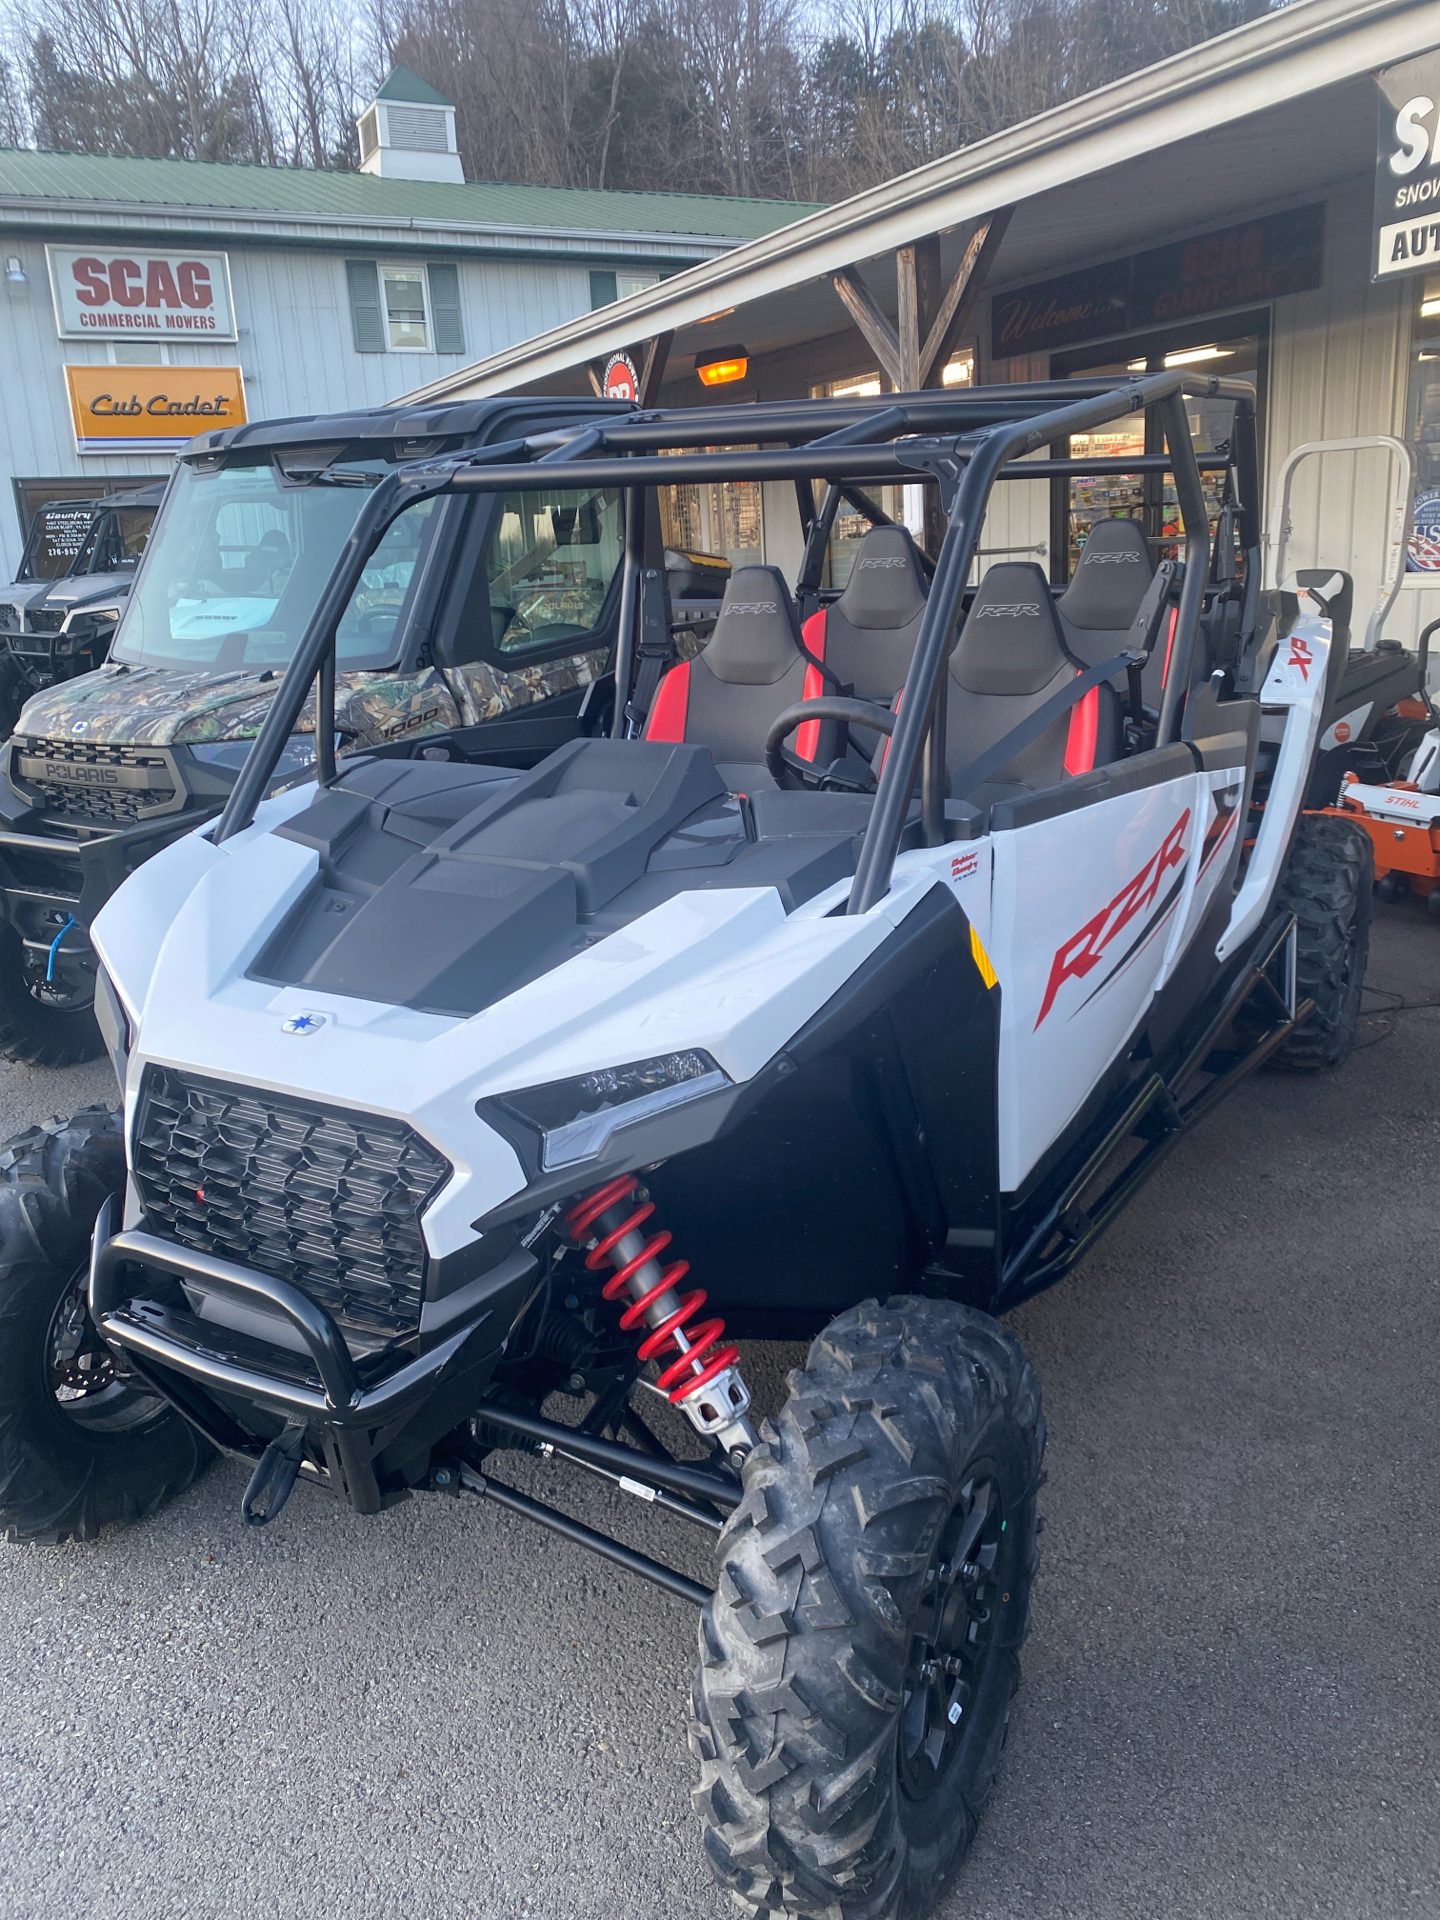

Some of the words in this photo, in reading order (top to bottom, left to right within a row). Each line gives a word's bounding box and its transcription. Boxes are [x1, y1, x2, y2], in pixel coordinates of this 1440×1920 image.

[71, 257, 213, 309] SCAG
[79, 313, 161, 328] COMMERCIAL
[165, 314, 216, 329] MOWERS
[90, 394, 142, 416] Cub
[146, 394, 229, 416] Cadet
[859, 557, 906, 570] RZR
[1084, 551, 1140, 565] RZR
[542, 602, 584, 610] POLARIS
[724, 601, 777, 616] RZR
[976, 603, 1040, 619] RZR
[1287, 636, 1313, 682] XP
[374, 686, 441, 728] XP
[384, 708, 439, 738] 1000
[45, 763, 119, 783] POLARIS
[1385, 796, 1420, 809] STIHL
[1032, 807, 1191, 1035] RZR
